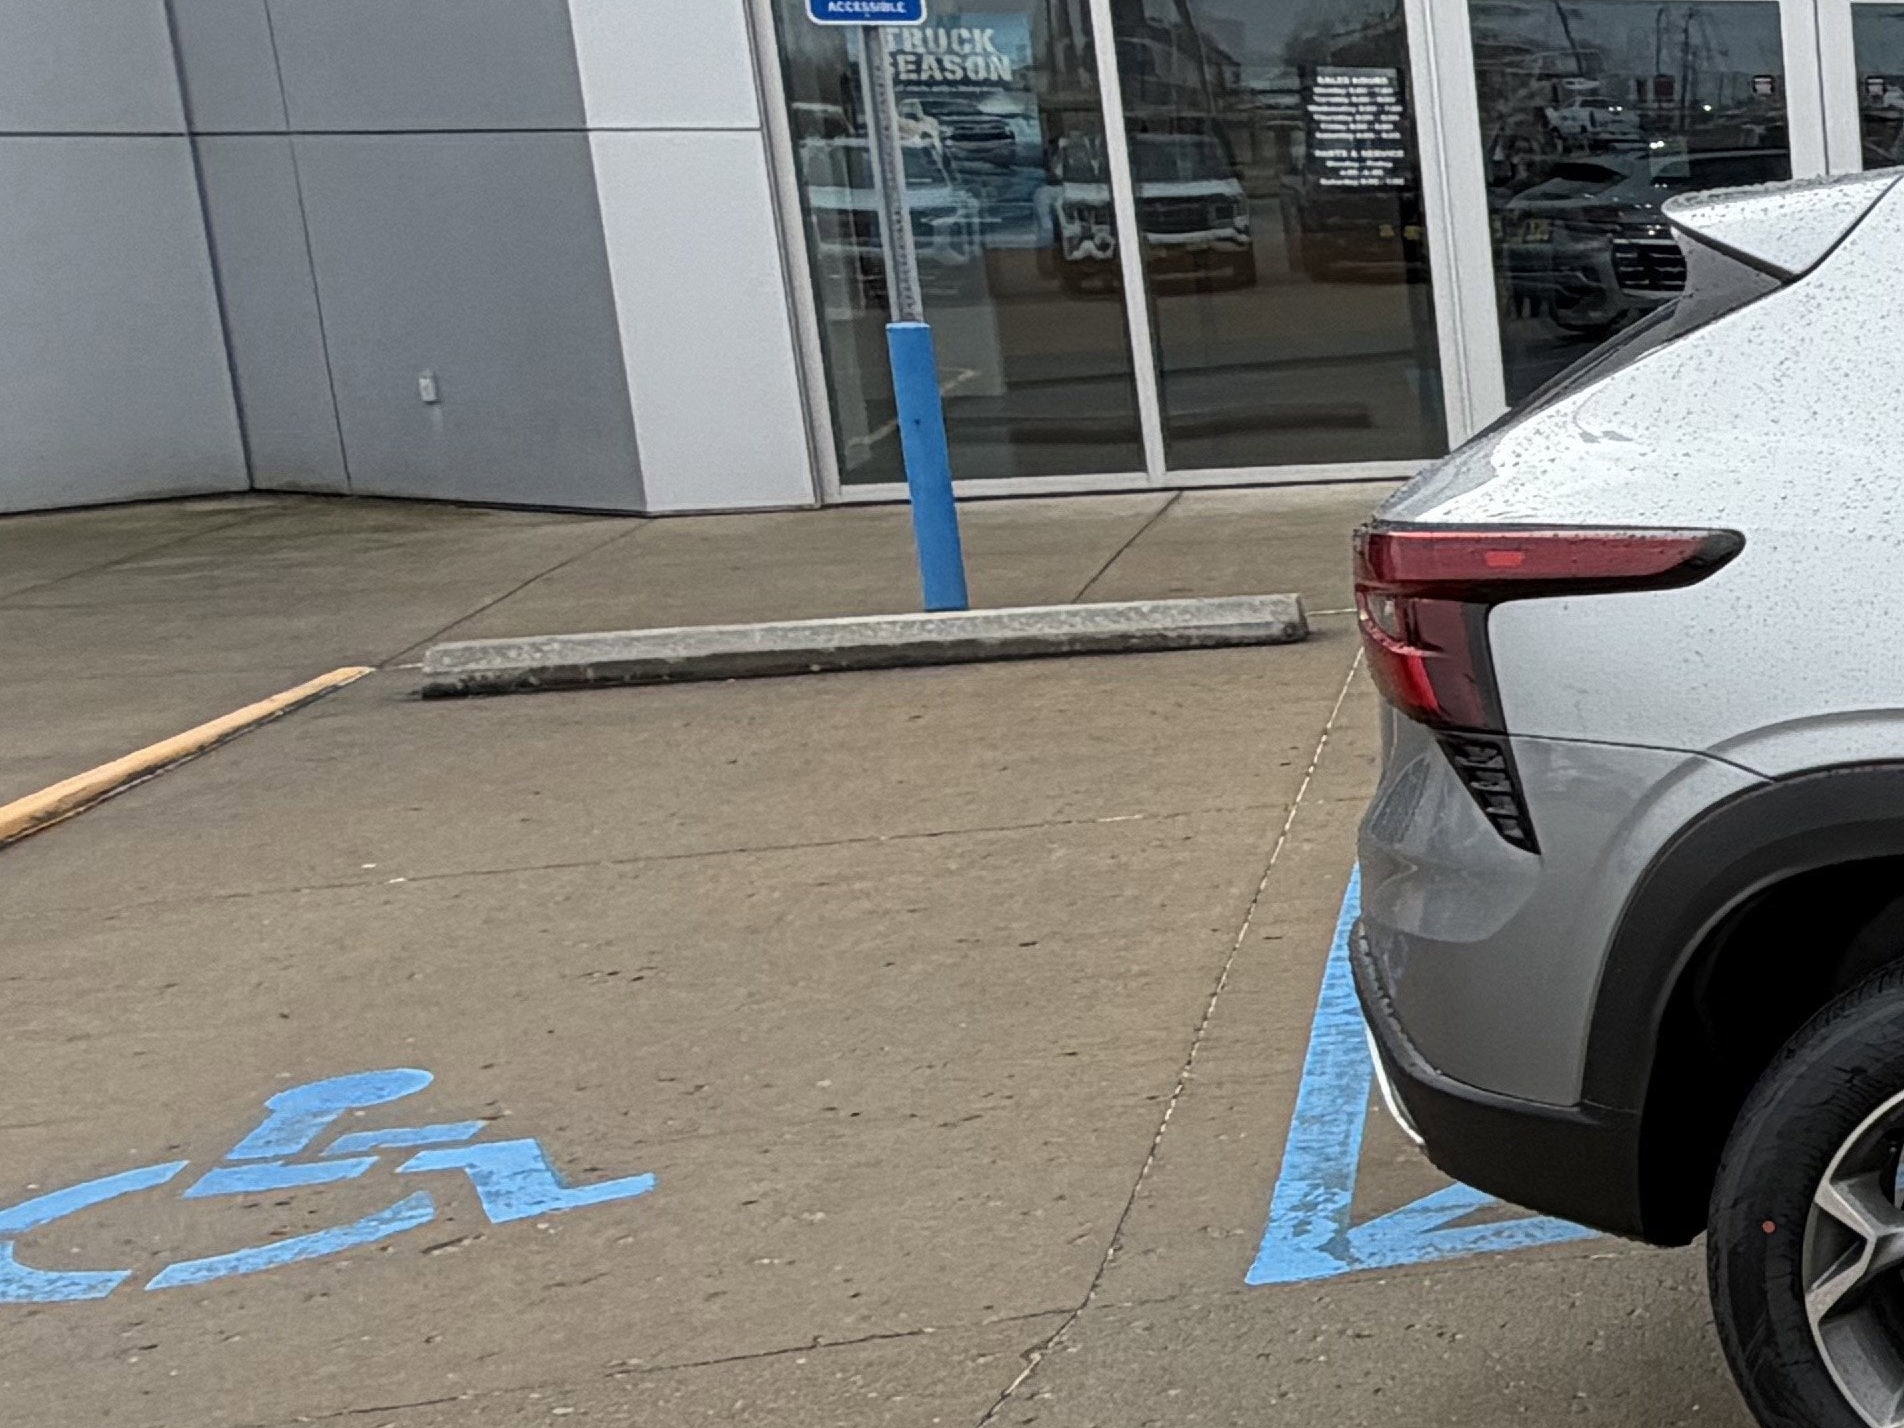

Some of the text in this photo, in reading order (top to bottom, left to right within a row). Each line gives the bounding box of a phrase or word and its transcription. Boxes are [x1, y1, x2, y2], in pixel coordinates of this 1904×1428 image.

[827, 0, 908, 14] ACCESSIBLE
[884, 26, 998, 55] TRUCK
[889, 53, 1013, 82] EASON
